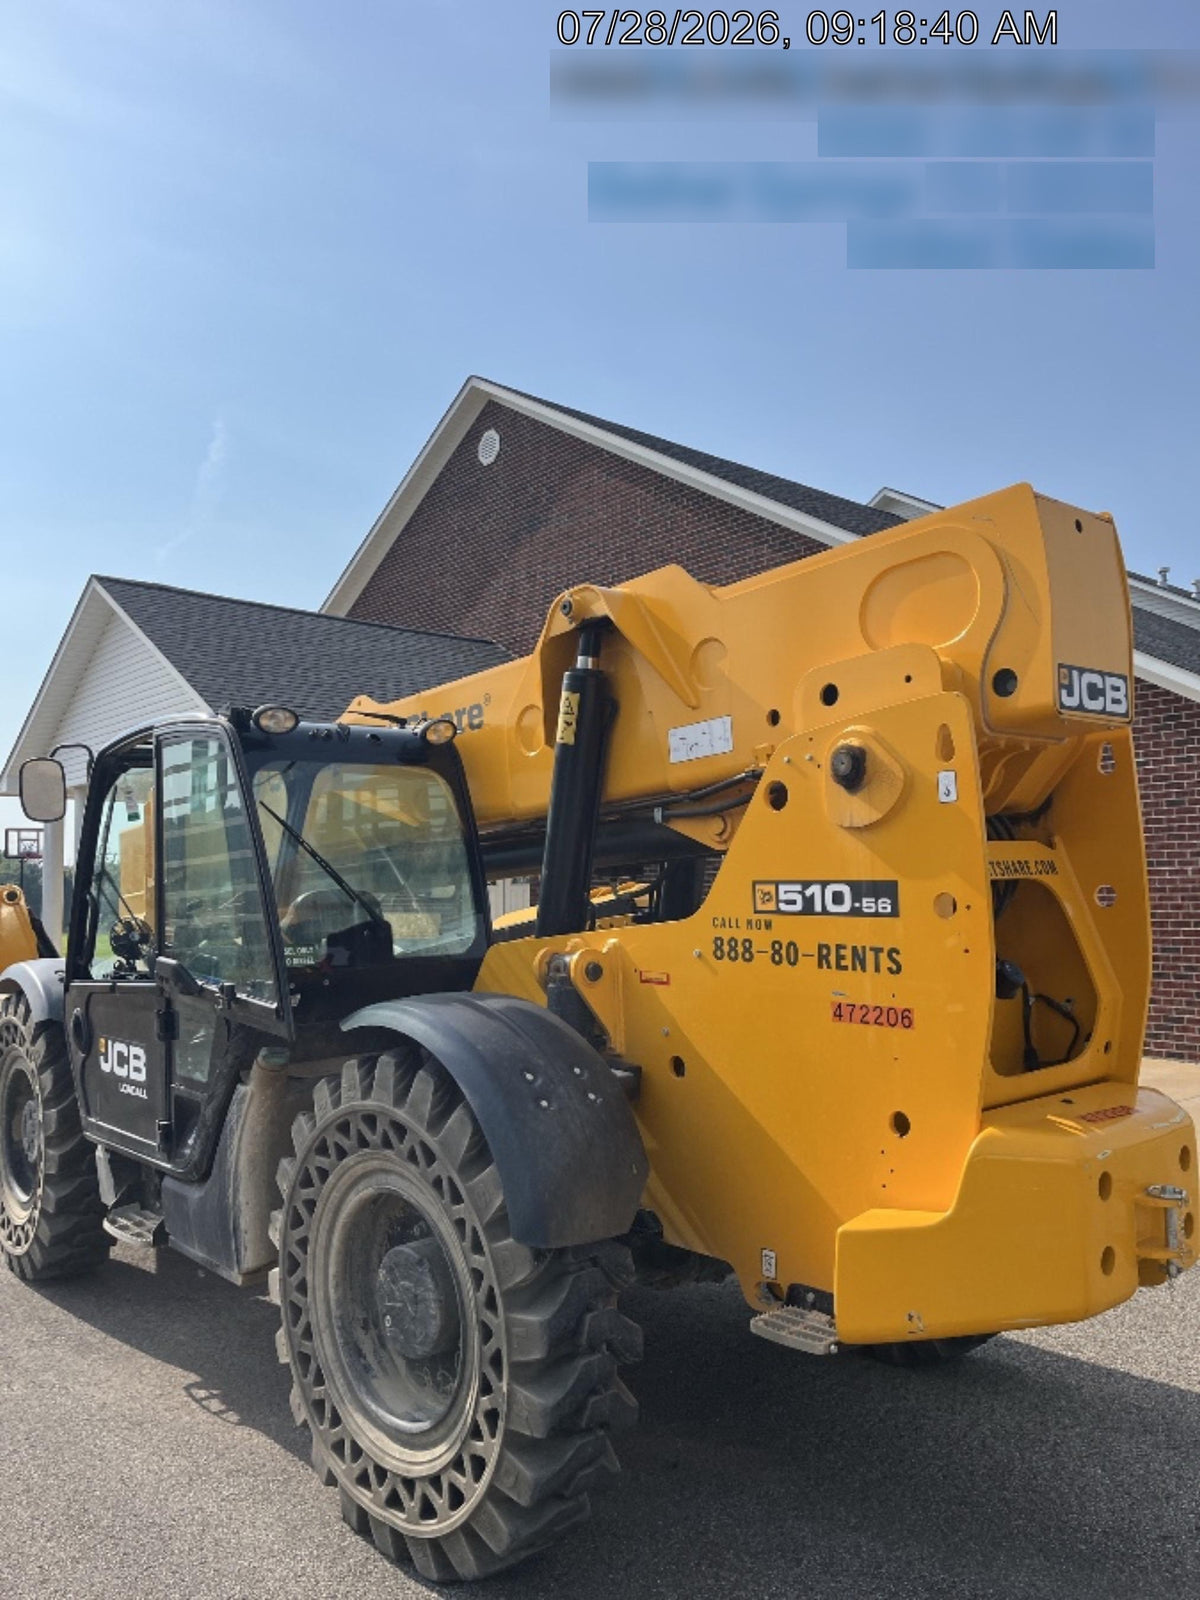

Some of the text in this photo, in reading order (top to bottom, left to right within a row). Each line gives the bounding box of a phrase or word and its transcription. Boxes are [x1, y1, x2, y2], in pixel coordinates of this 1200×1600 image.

[1061, 669, 1128, 714] JCB
[988, 860, 1059, 877] TSHARE.COM
[777, 883, 892, 913] 510-56
[712, 917, 773, 931] CALL NOW
[712, 936, 903, 976] 888-80-RENTS
[832, 1001, 914, 1029] 472206
[99, 1039, 147, 1082] JCB
